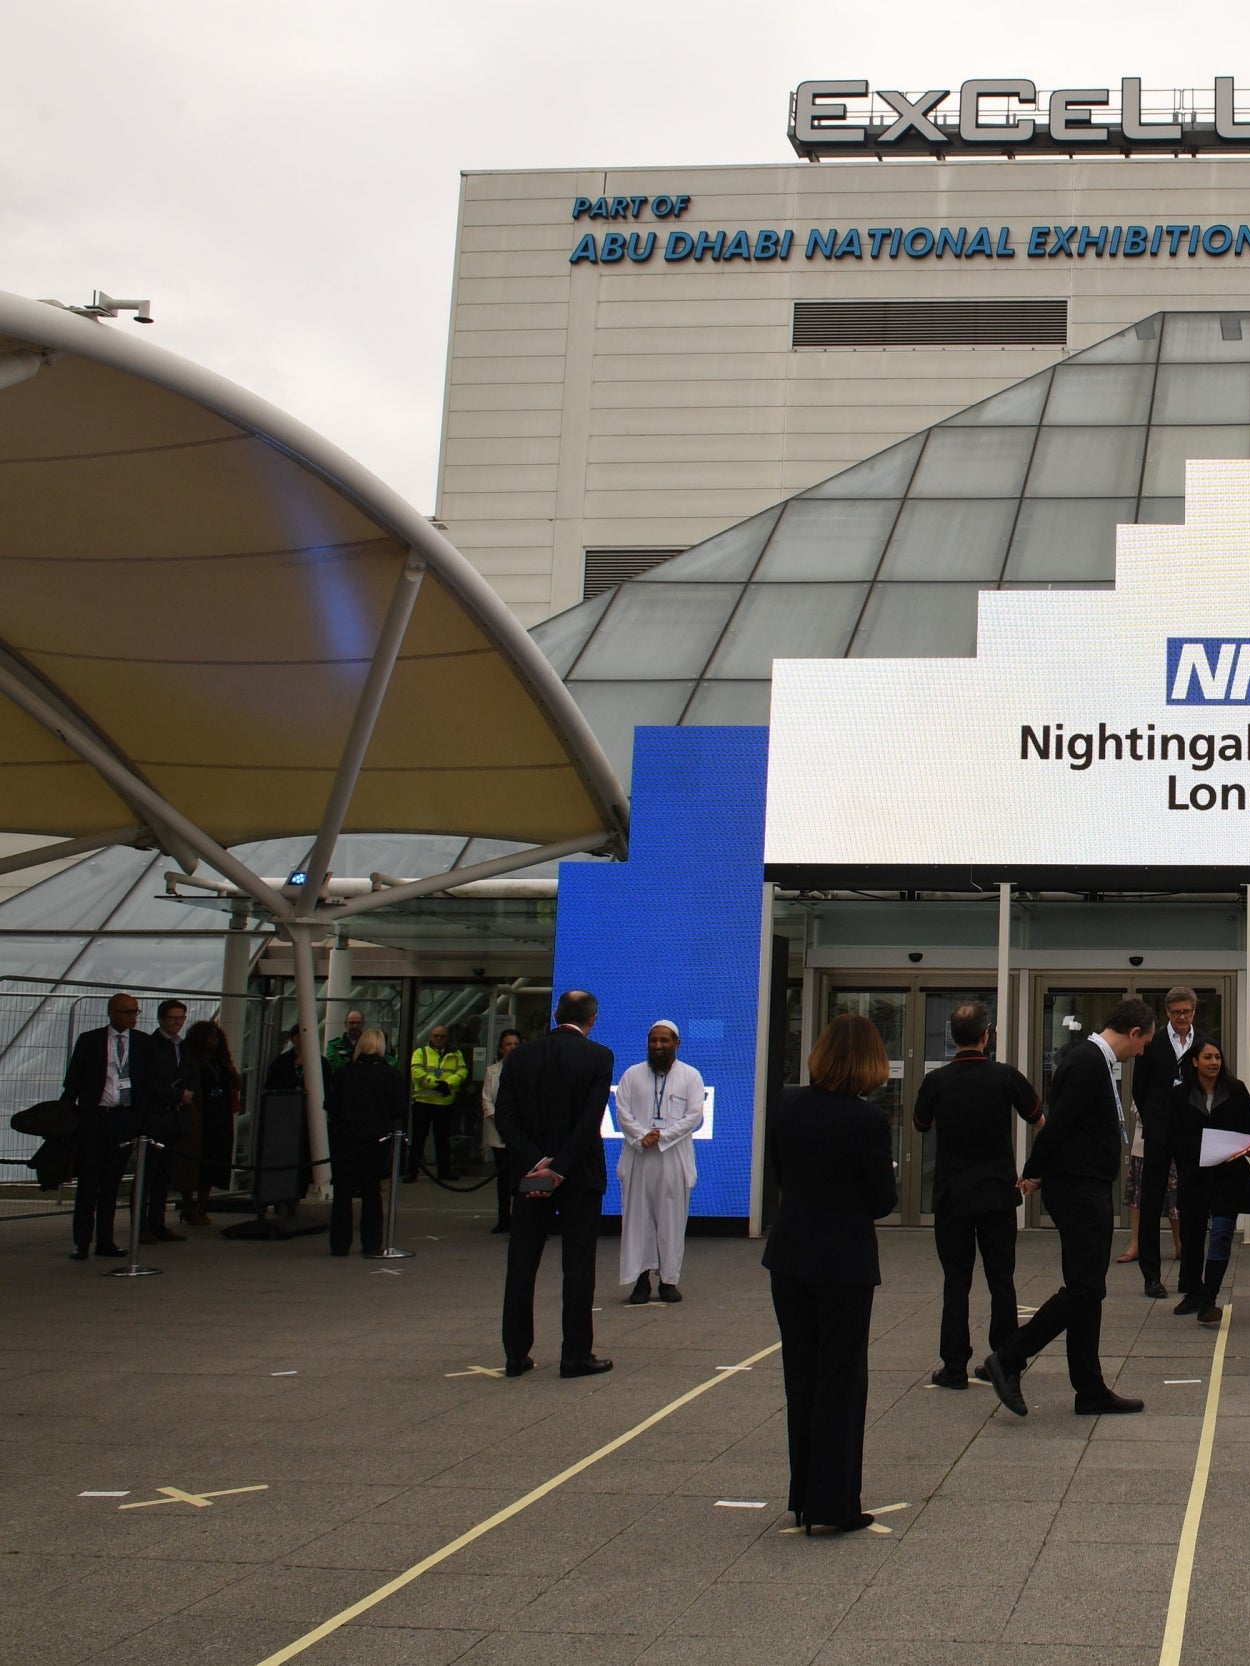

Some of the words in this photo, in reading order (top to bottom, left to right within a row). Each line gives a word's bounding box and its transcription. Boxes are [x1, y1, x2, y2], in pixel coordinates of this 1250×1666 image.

[571, 196, 649, 219] PART
[651, 195, 691, 217] OF
[570, 232, 658, 264] ABU
[663, 229, 793, 262] DHABI
[805, 226, 1016, 260] NATIONAL
